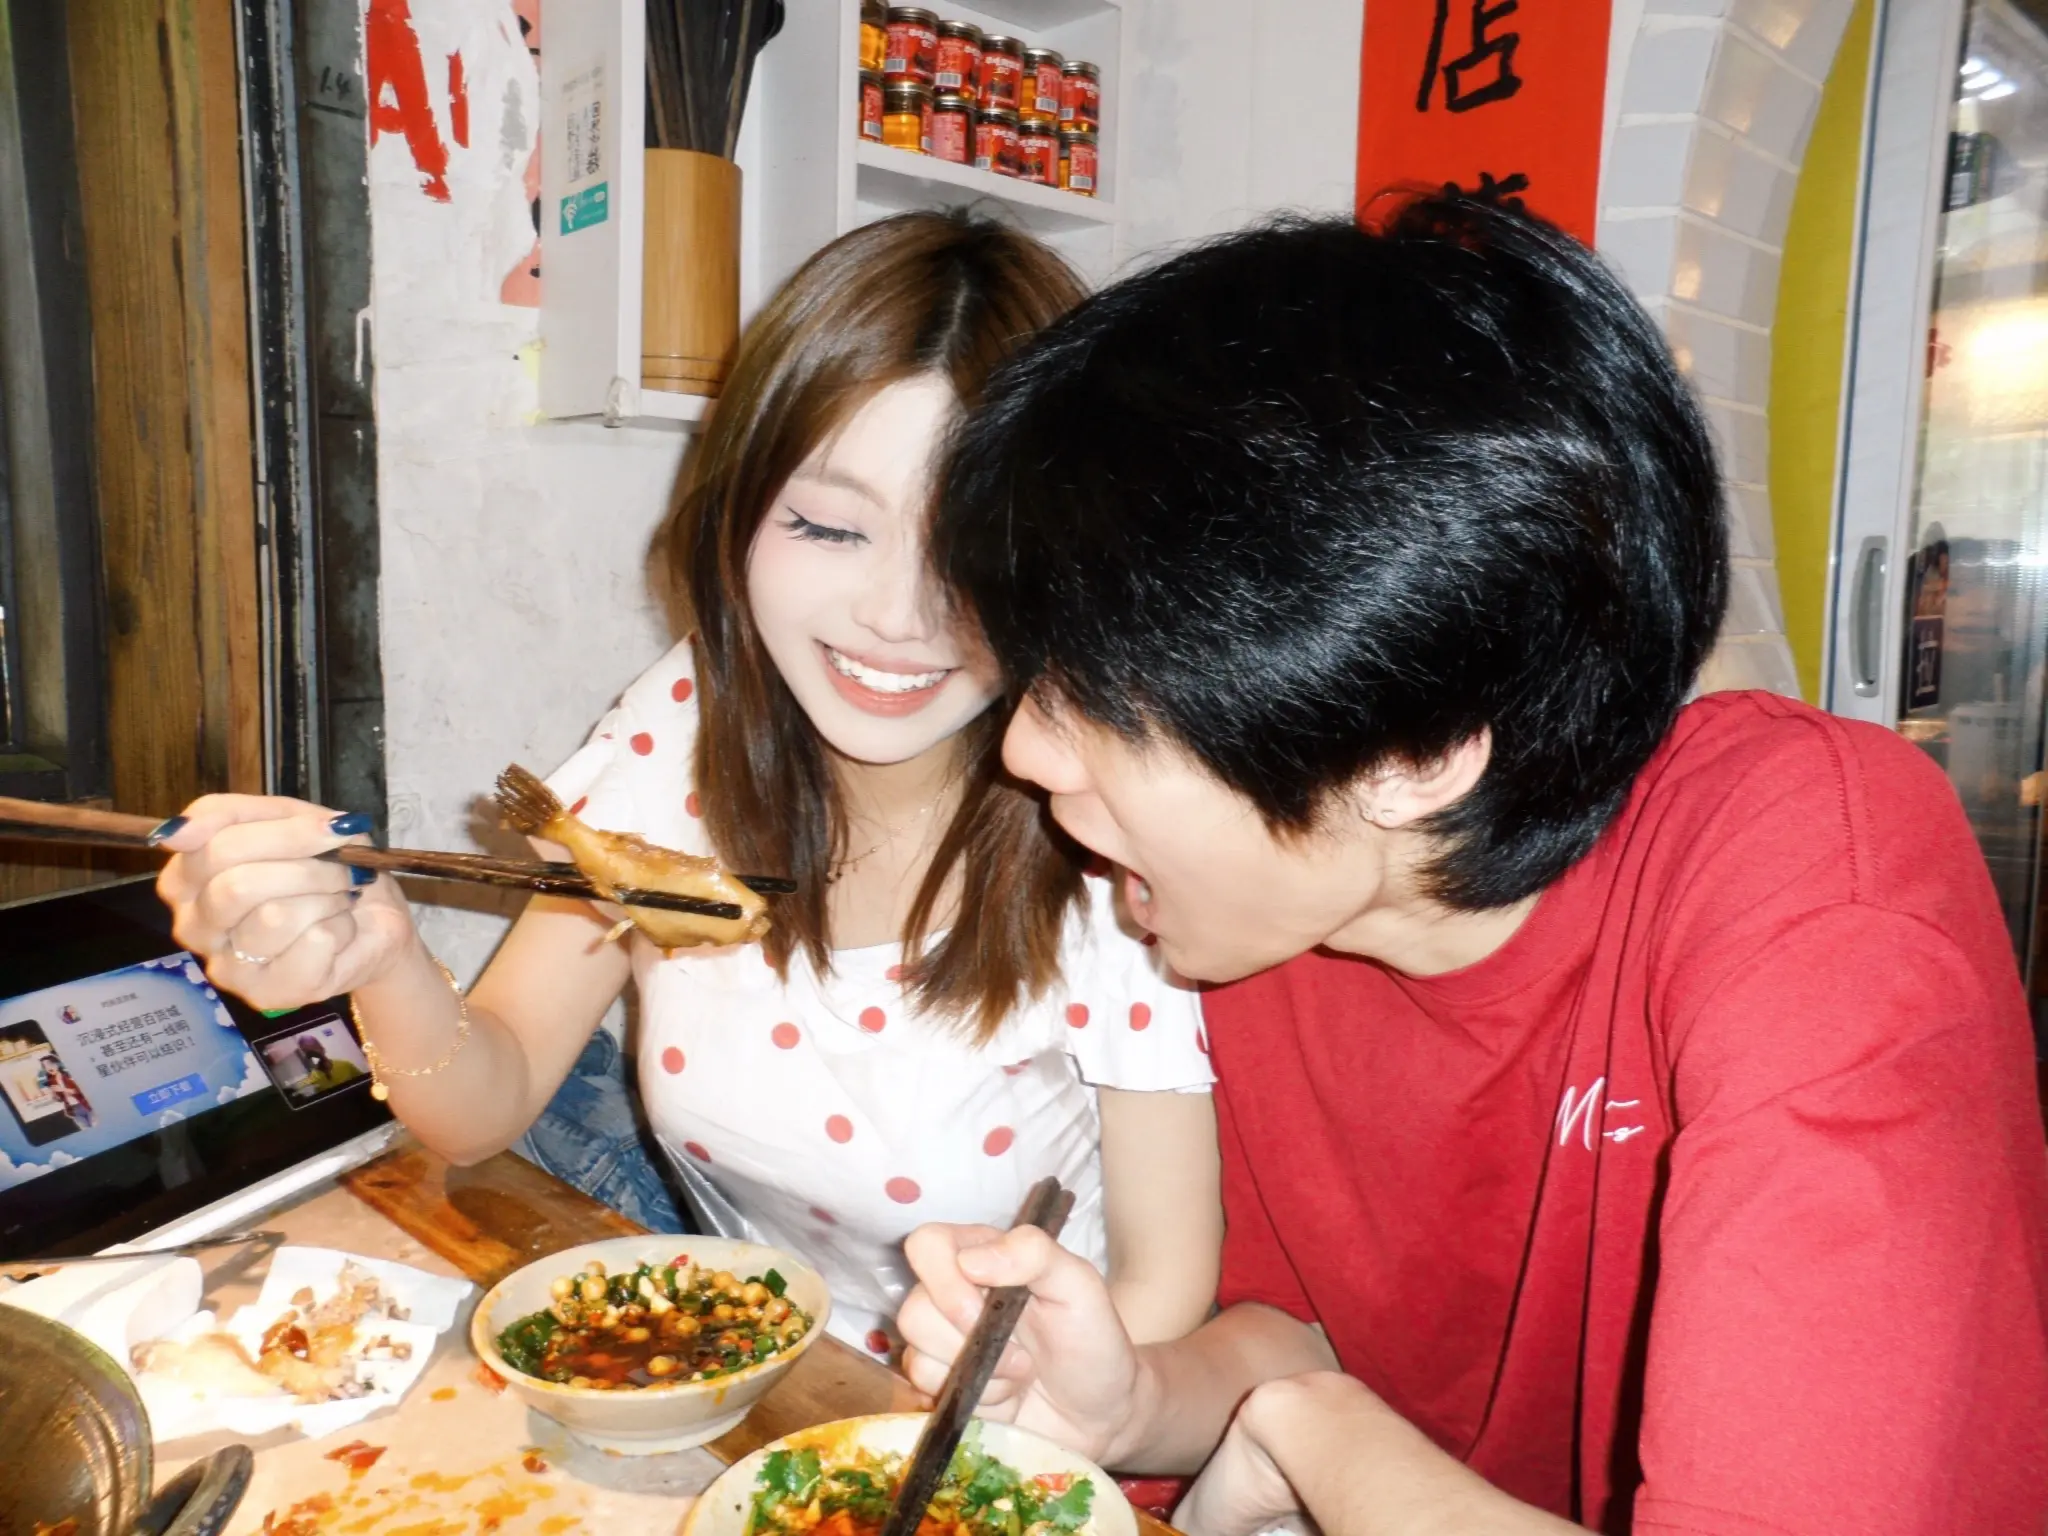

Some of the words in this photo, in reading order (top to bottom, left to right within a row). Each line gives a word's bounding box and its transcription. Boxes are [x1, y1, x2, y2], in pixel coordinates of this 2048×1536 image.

[76, 1004, 182, 1047] 沉浸式经营百货城
